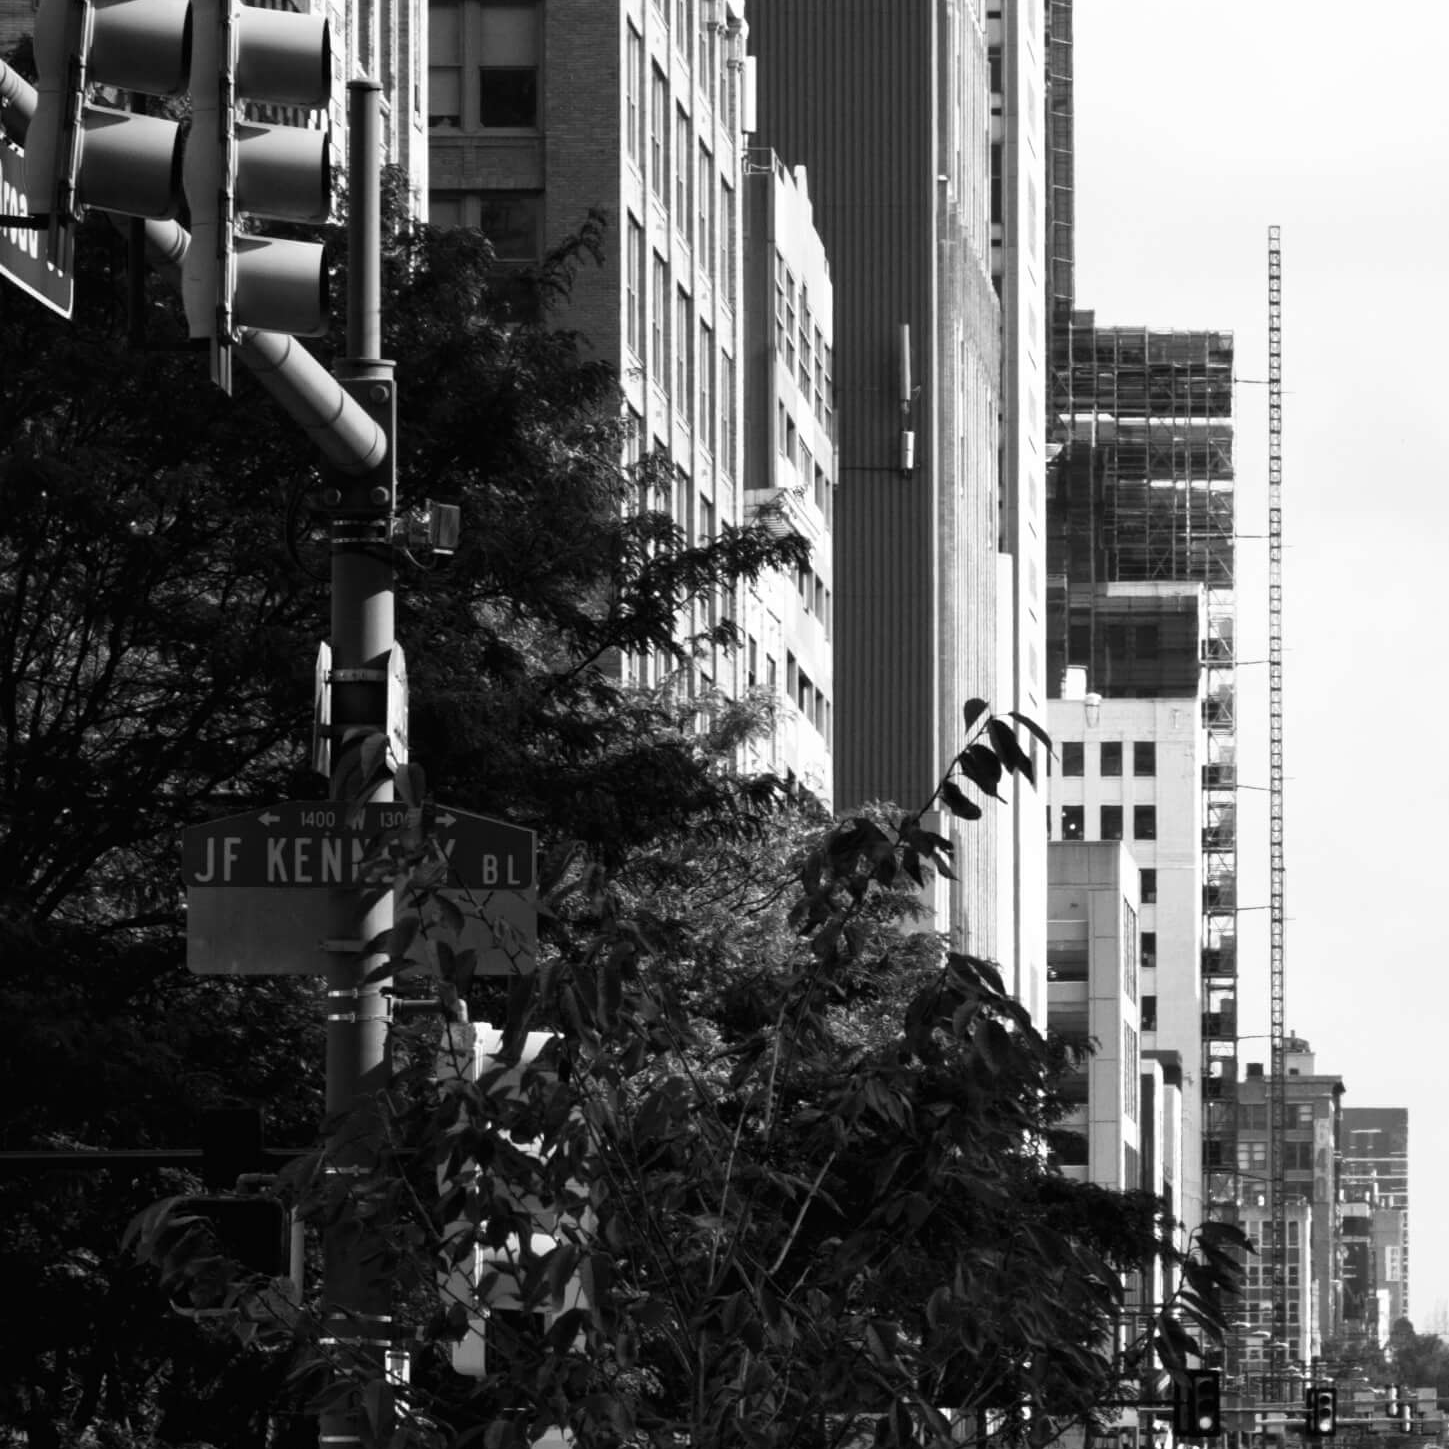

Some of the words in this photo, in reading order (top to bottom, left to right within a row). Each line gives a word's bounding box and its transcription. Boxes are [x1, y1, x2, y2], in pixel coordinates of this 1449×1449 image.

[300, 810, 336, 828] 1400
[194, 837, 243, 883] JF
[482, 854, 521, 886] BL
